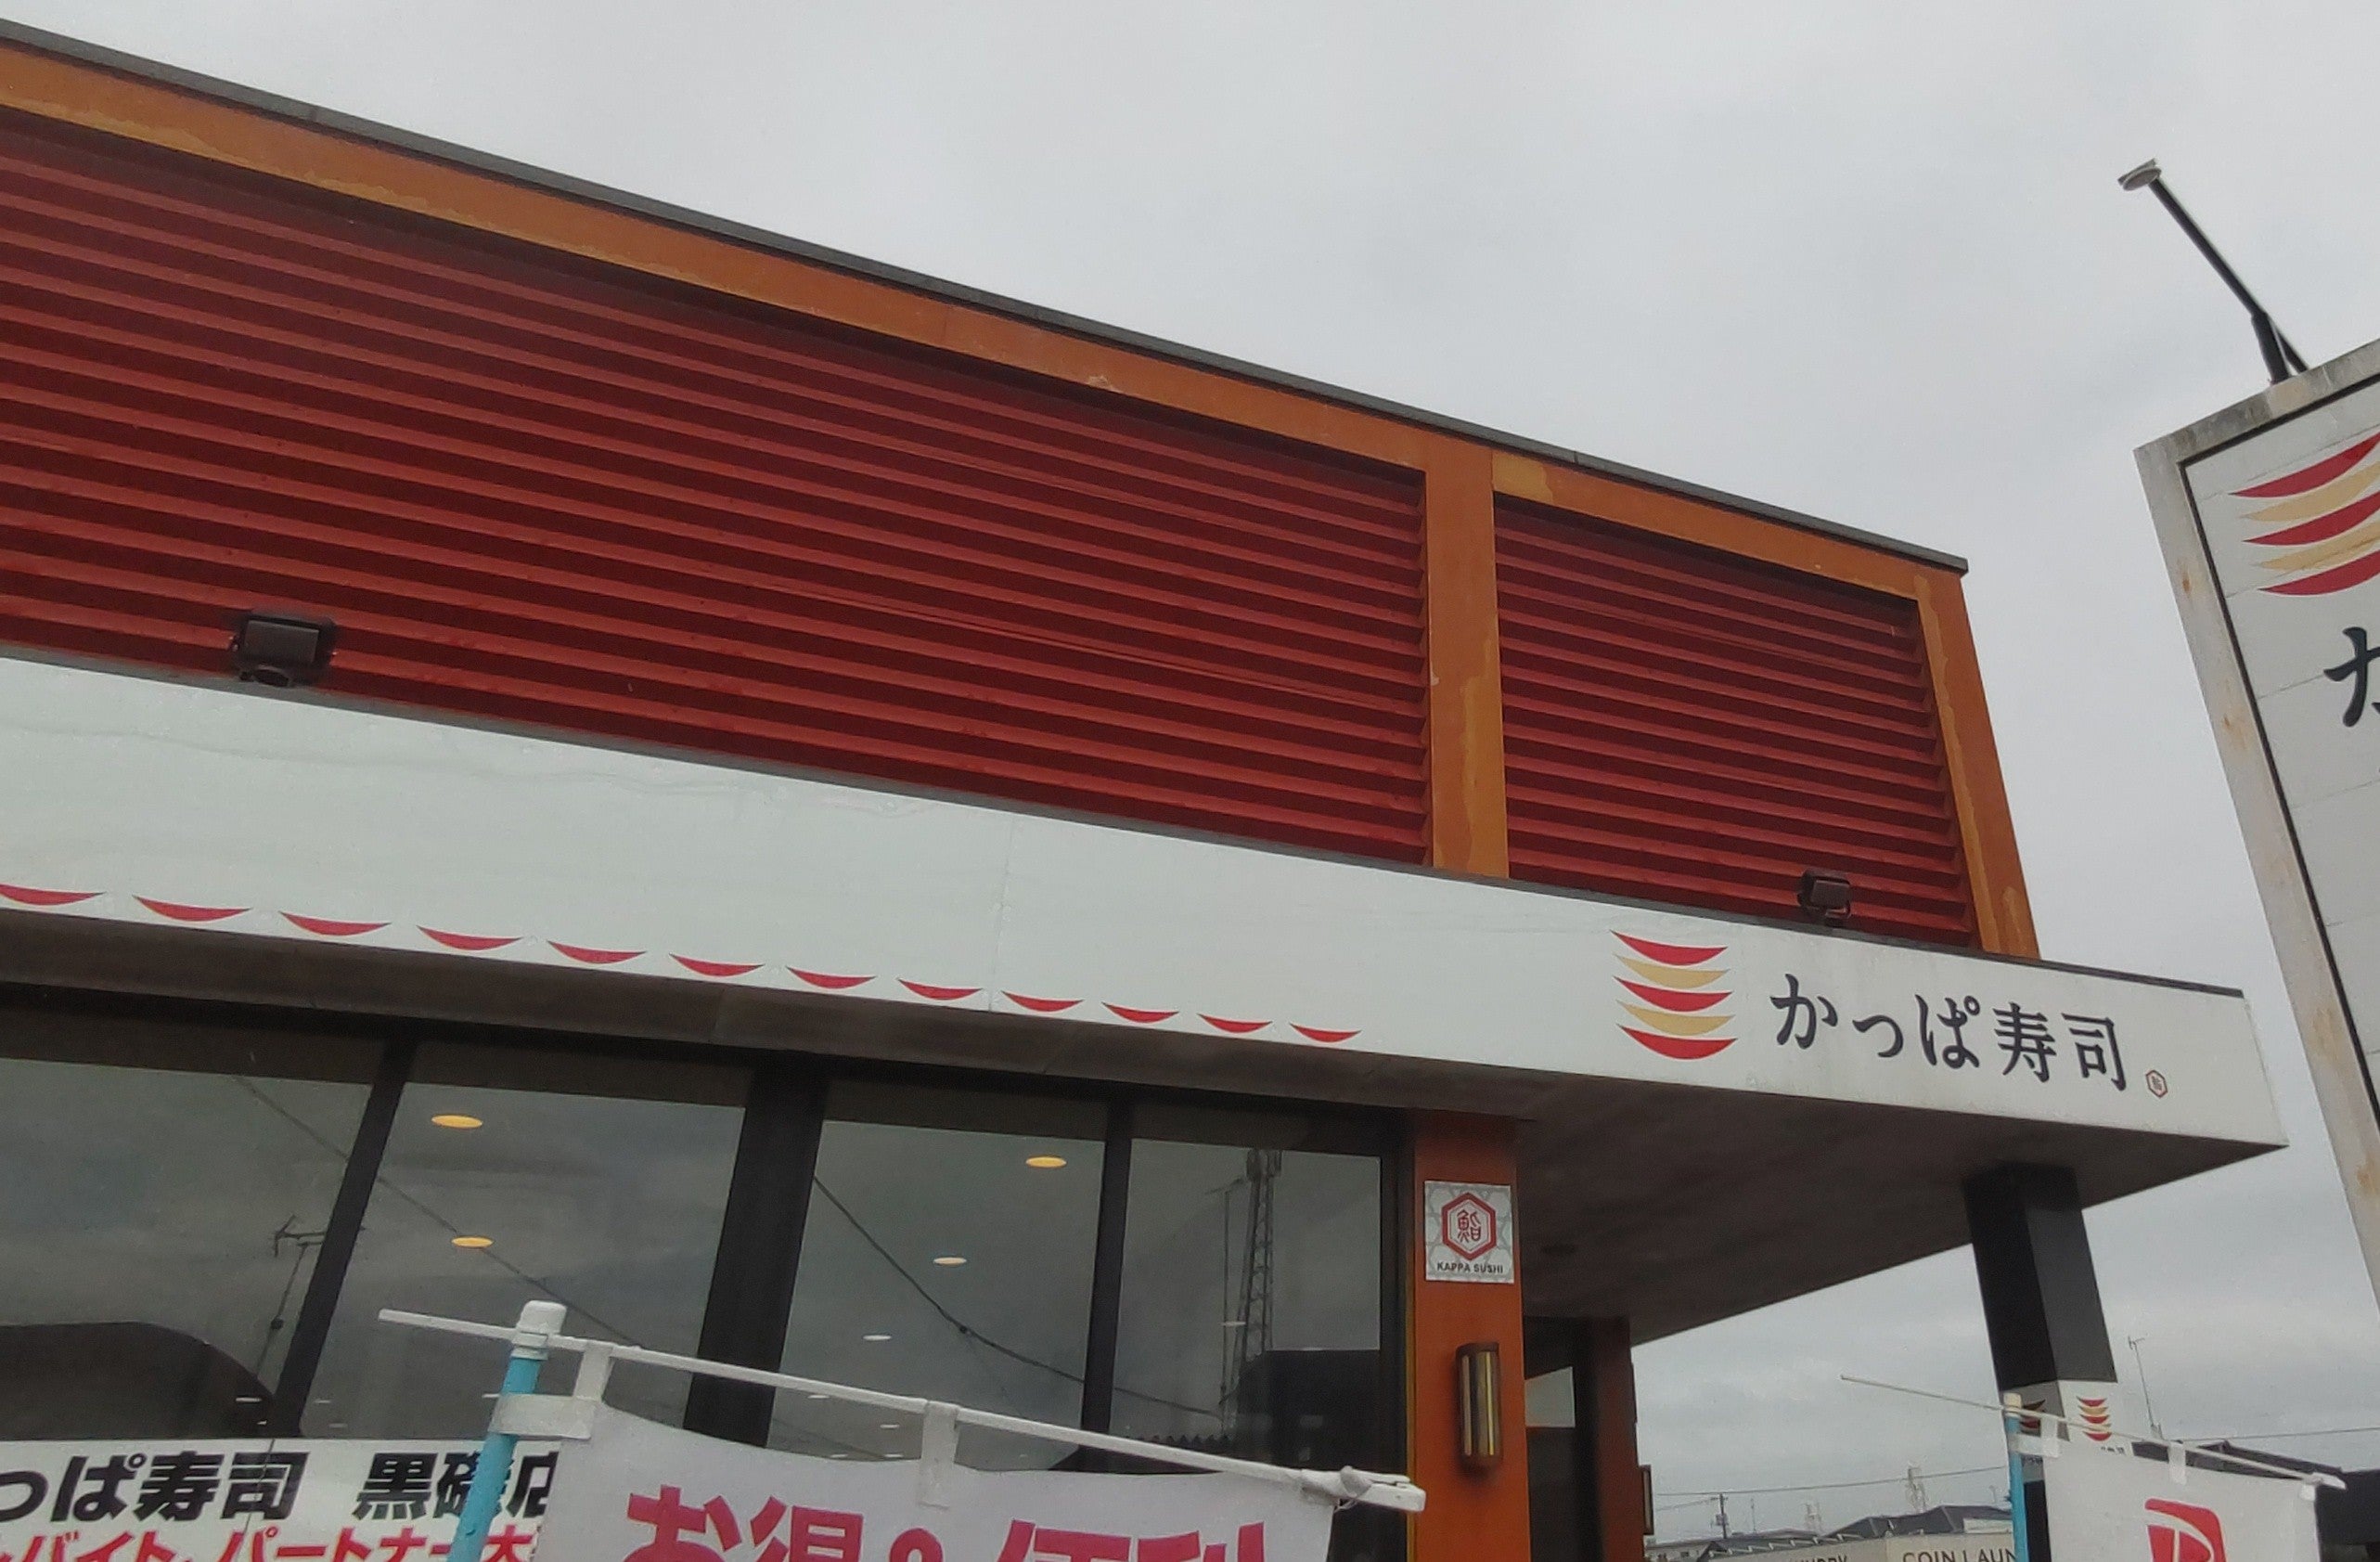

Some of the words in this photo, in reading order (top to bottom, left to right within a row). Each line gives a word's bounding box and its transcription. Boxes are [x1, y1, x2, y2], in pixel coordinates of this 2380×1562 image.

[1769, 973, 2128, 1092] かっぱ寿司
[1436, 1262, 1472, 1273] KAPPA
[1473, 1263, 1504, 1274] SUSHI
